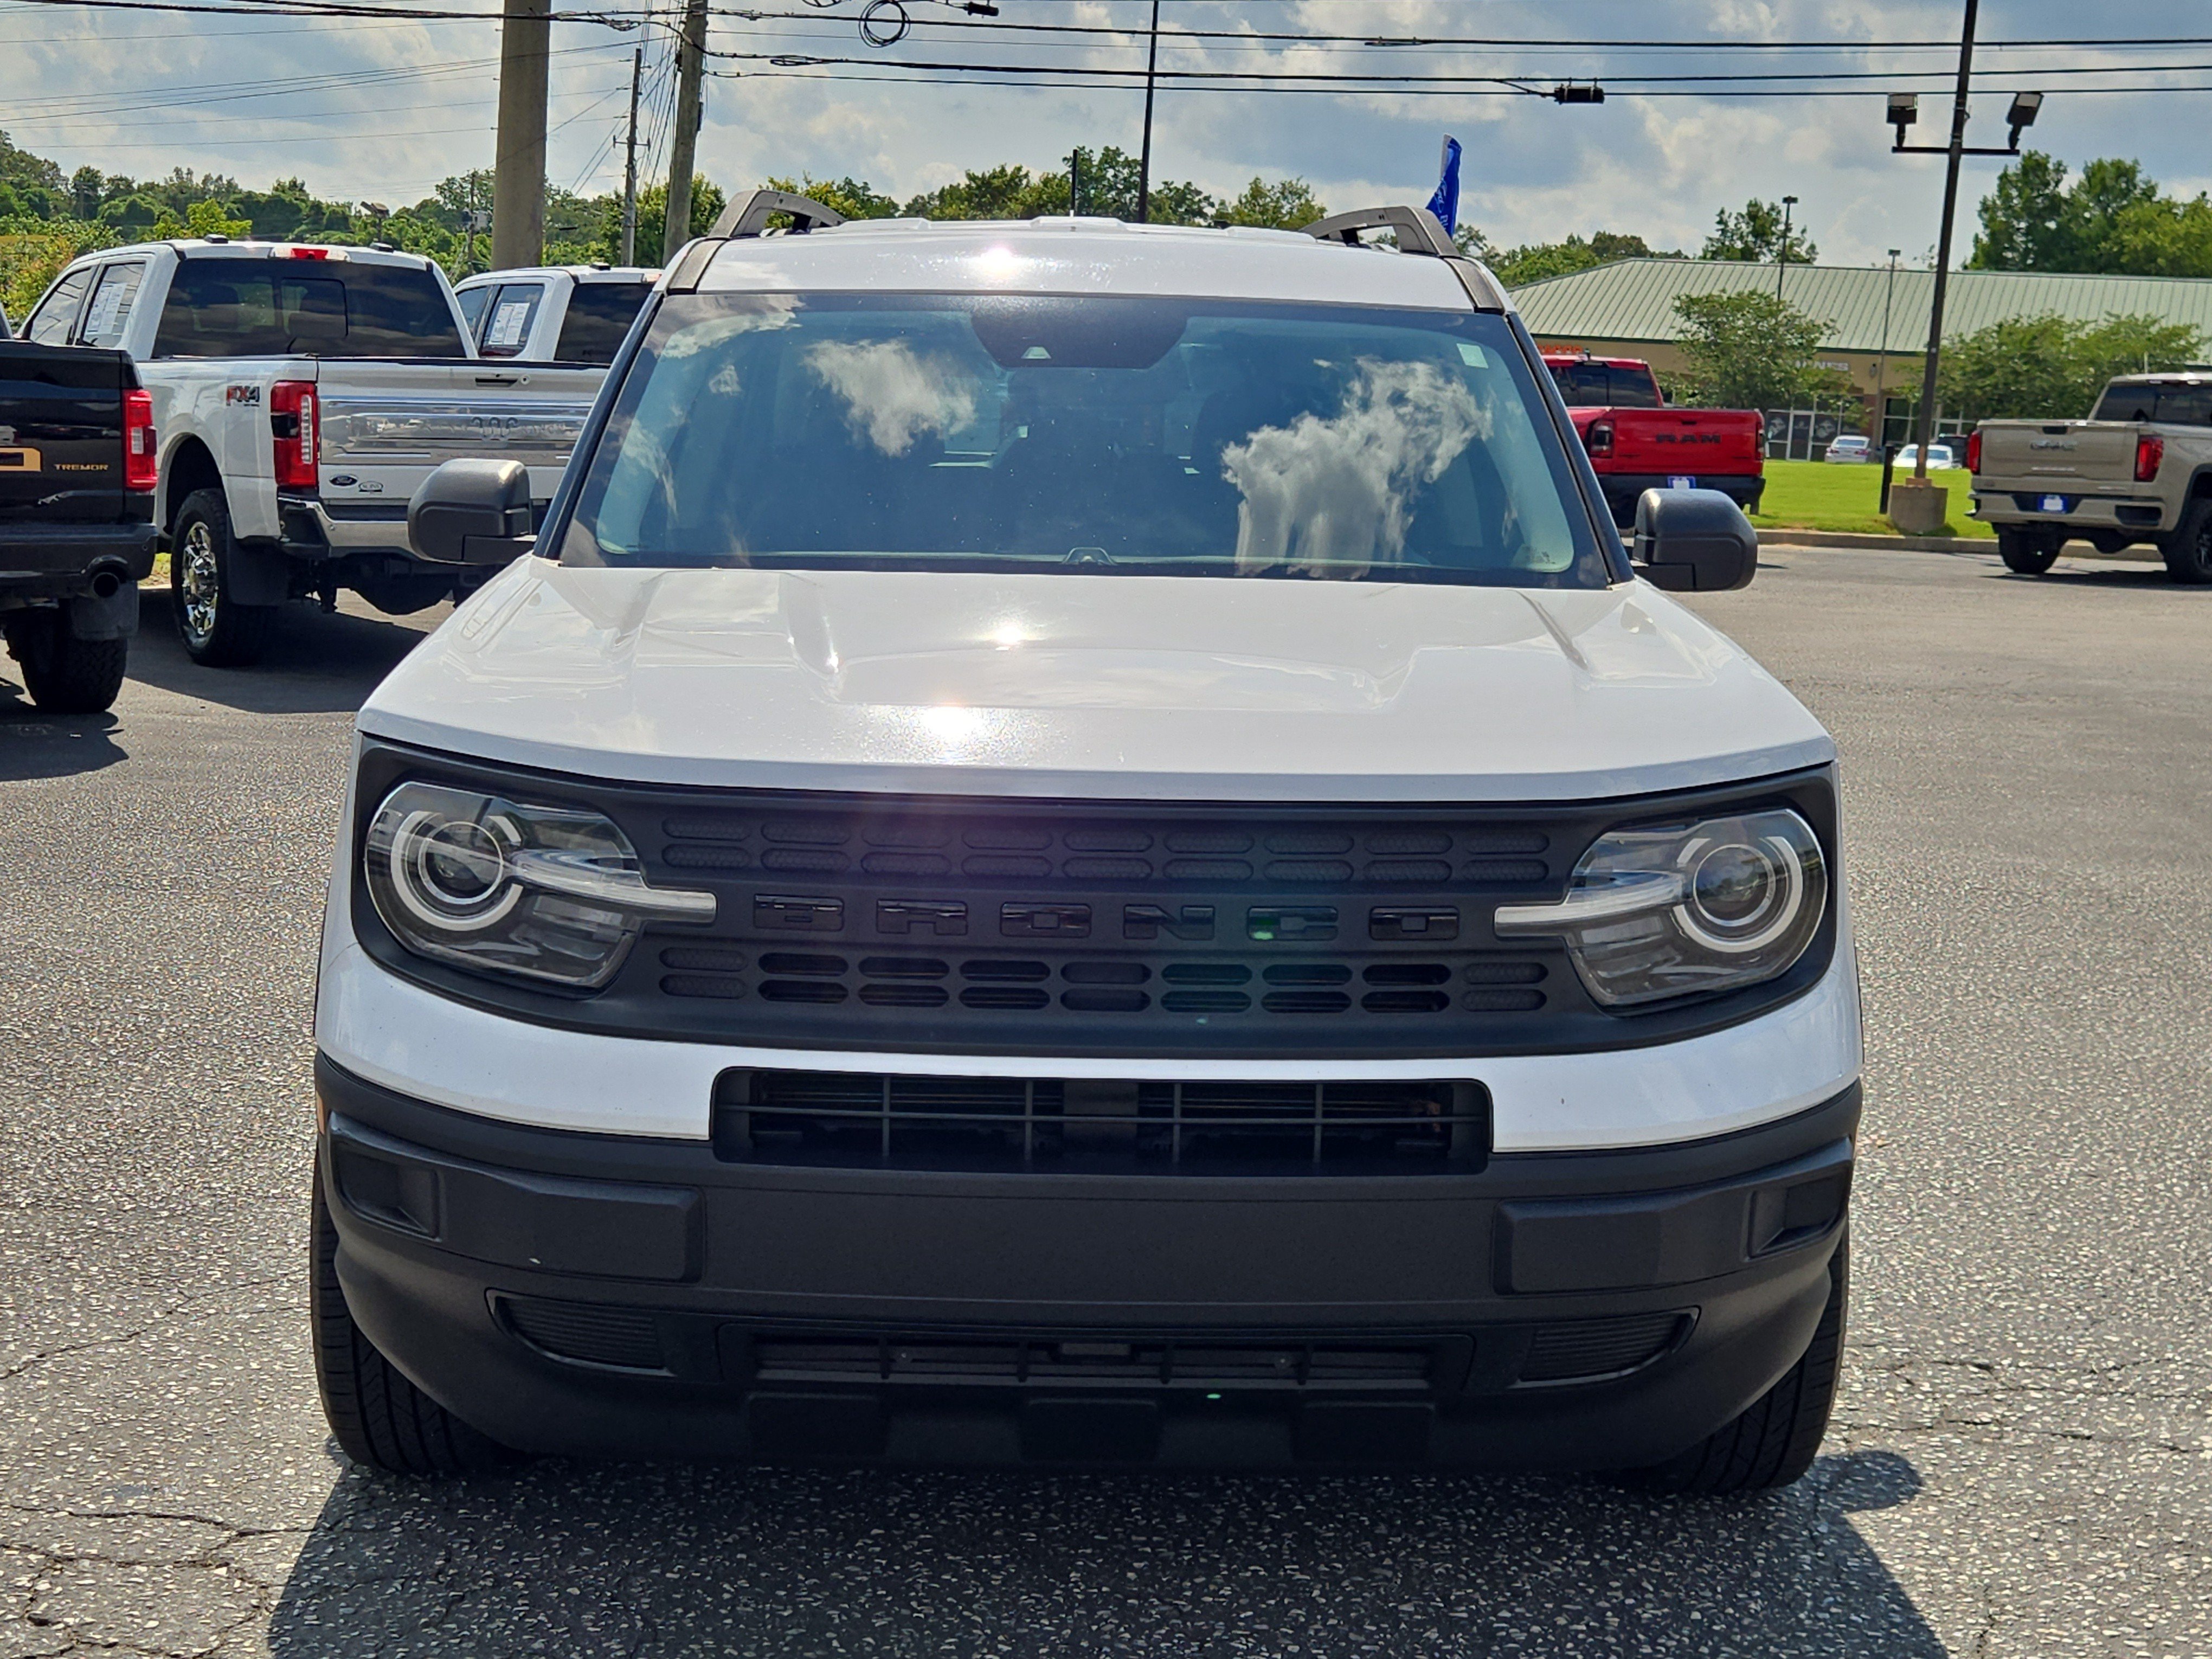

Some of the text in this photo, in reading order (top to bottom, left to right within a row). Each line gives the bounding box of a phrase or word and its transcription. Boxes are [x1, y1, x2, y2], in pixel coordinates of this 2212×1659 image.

[226, 385, 260, 406] FX4
[1656, 434, 1721, 443] RAM
[754, 893, 1459, 941] BRONCO
